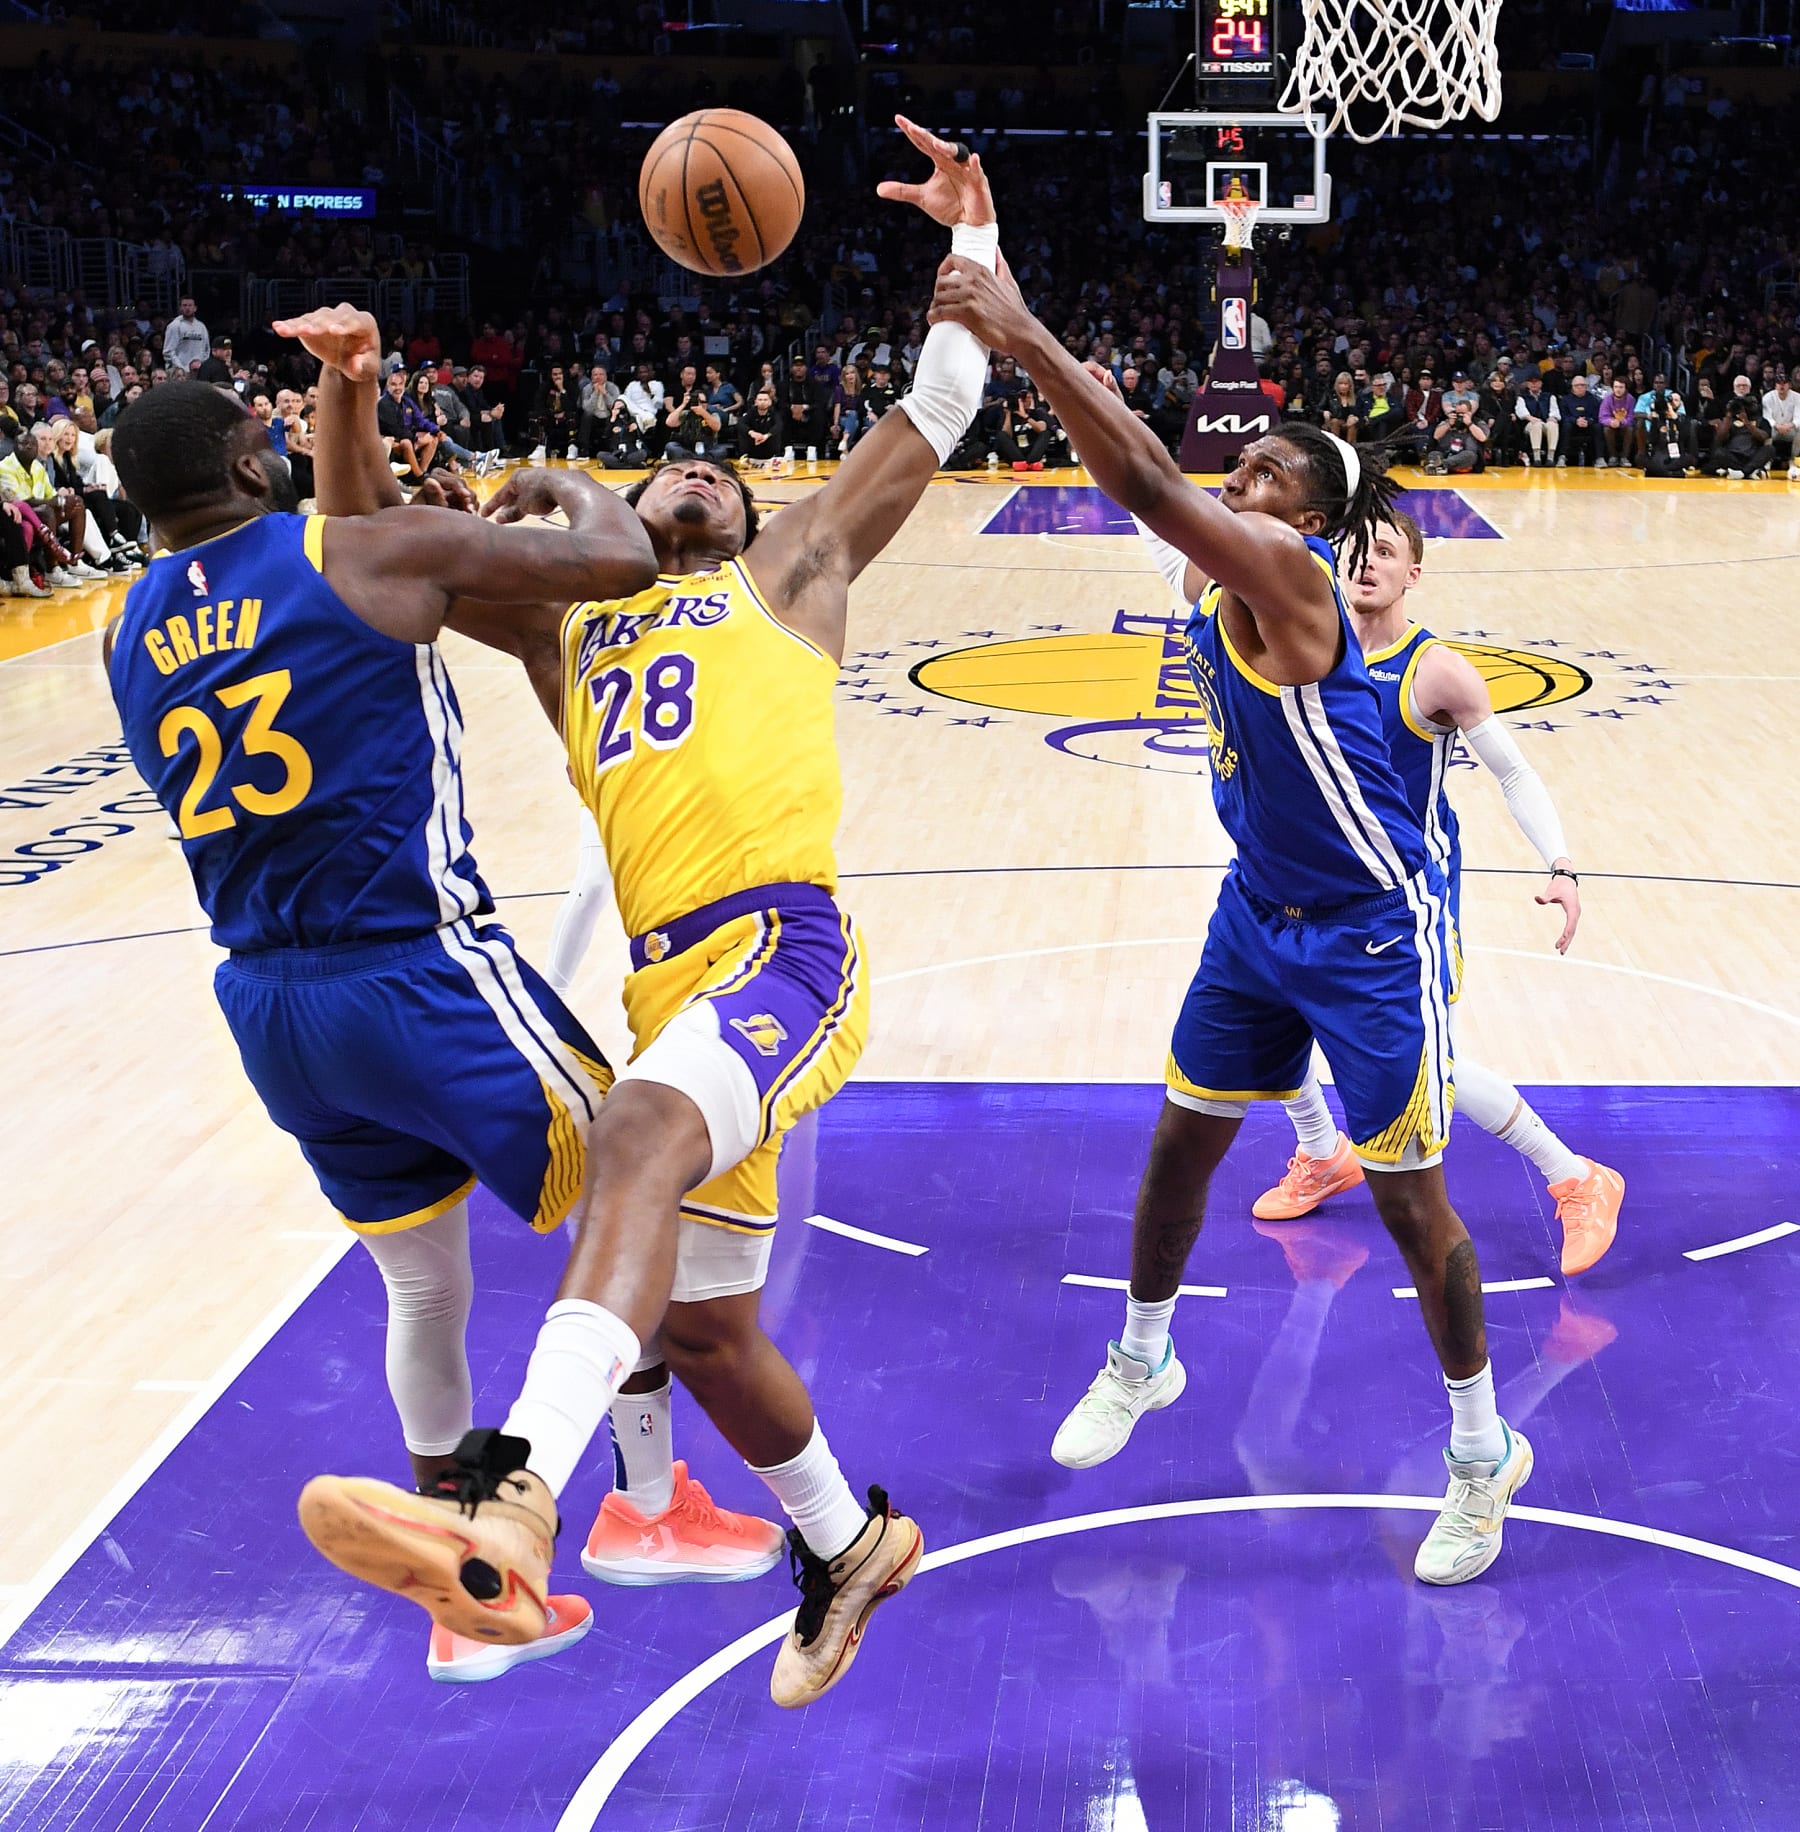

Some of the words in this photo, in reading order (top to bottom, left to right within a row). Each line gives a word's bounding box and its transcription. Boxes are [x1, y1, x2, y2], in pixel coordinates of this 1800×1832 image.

[1212, 18, 1262, 55] 24
[1221, 62, 1272, 73] TISSOT
[293, 194, 363, 209] EXPRESS
[1211, 380, 1239, 391] Google
[144, 598, 263, 676] GREEN
[1368, 668, 1401, 682] Rakuten
[590, 653, 696, 767] 28
[158, 669, 314, 840] 23
